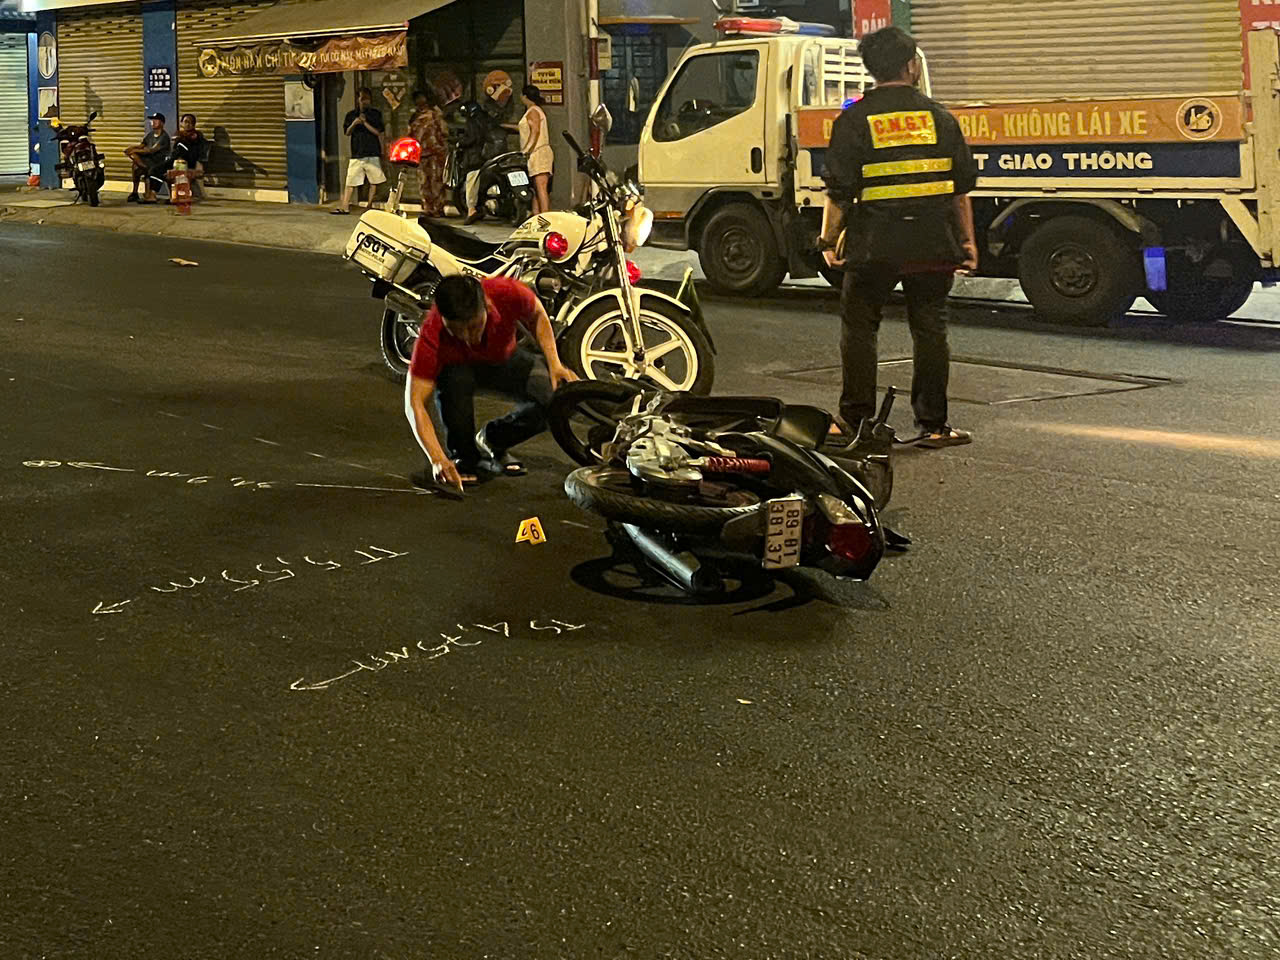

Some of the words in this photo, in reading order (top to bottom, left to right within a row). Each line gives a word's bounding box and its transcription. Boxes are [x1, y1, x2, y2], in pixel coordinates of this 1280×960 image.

[959, 113, 997, 141] BIA,
[1003, 107, 1071, 137] KHÔNG
[1077, 106, 1111, 136] LÁI
[1119, 110, 1147, 135] XE
[998, 153, 1053, 170] GIAO
[1062, 150, 1153, 170] THÔNG
